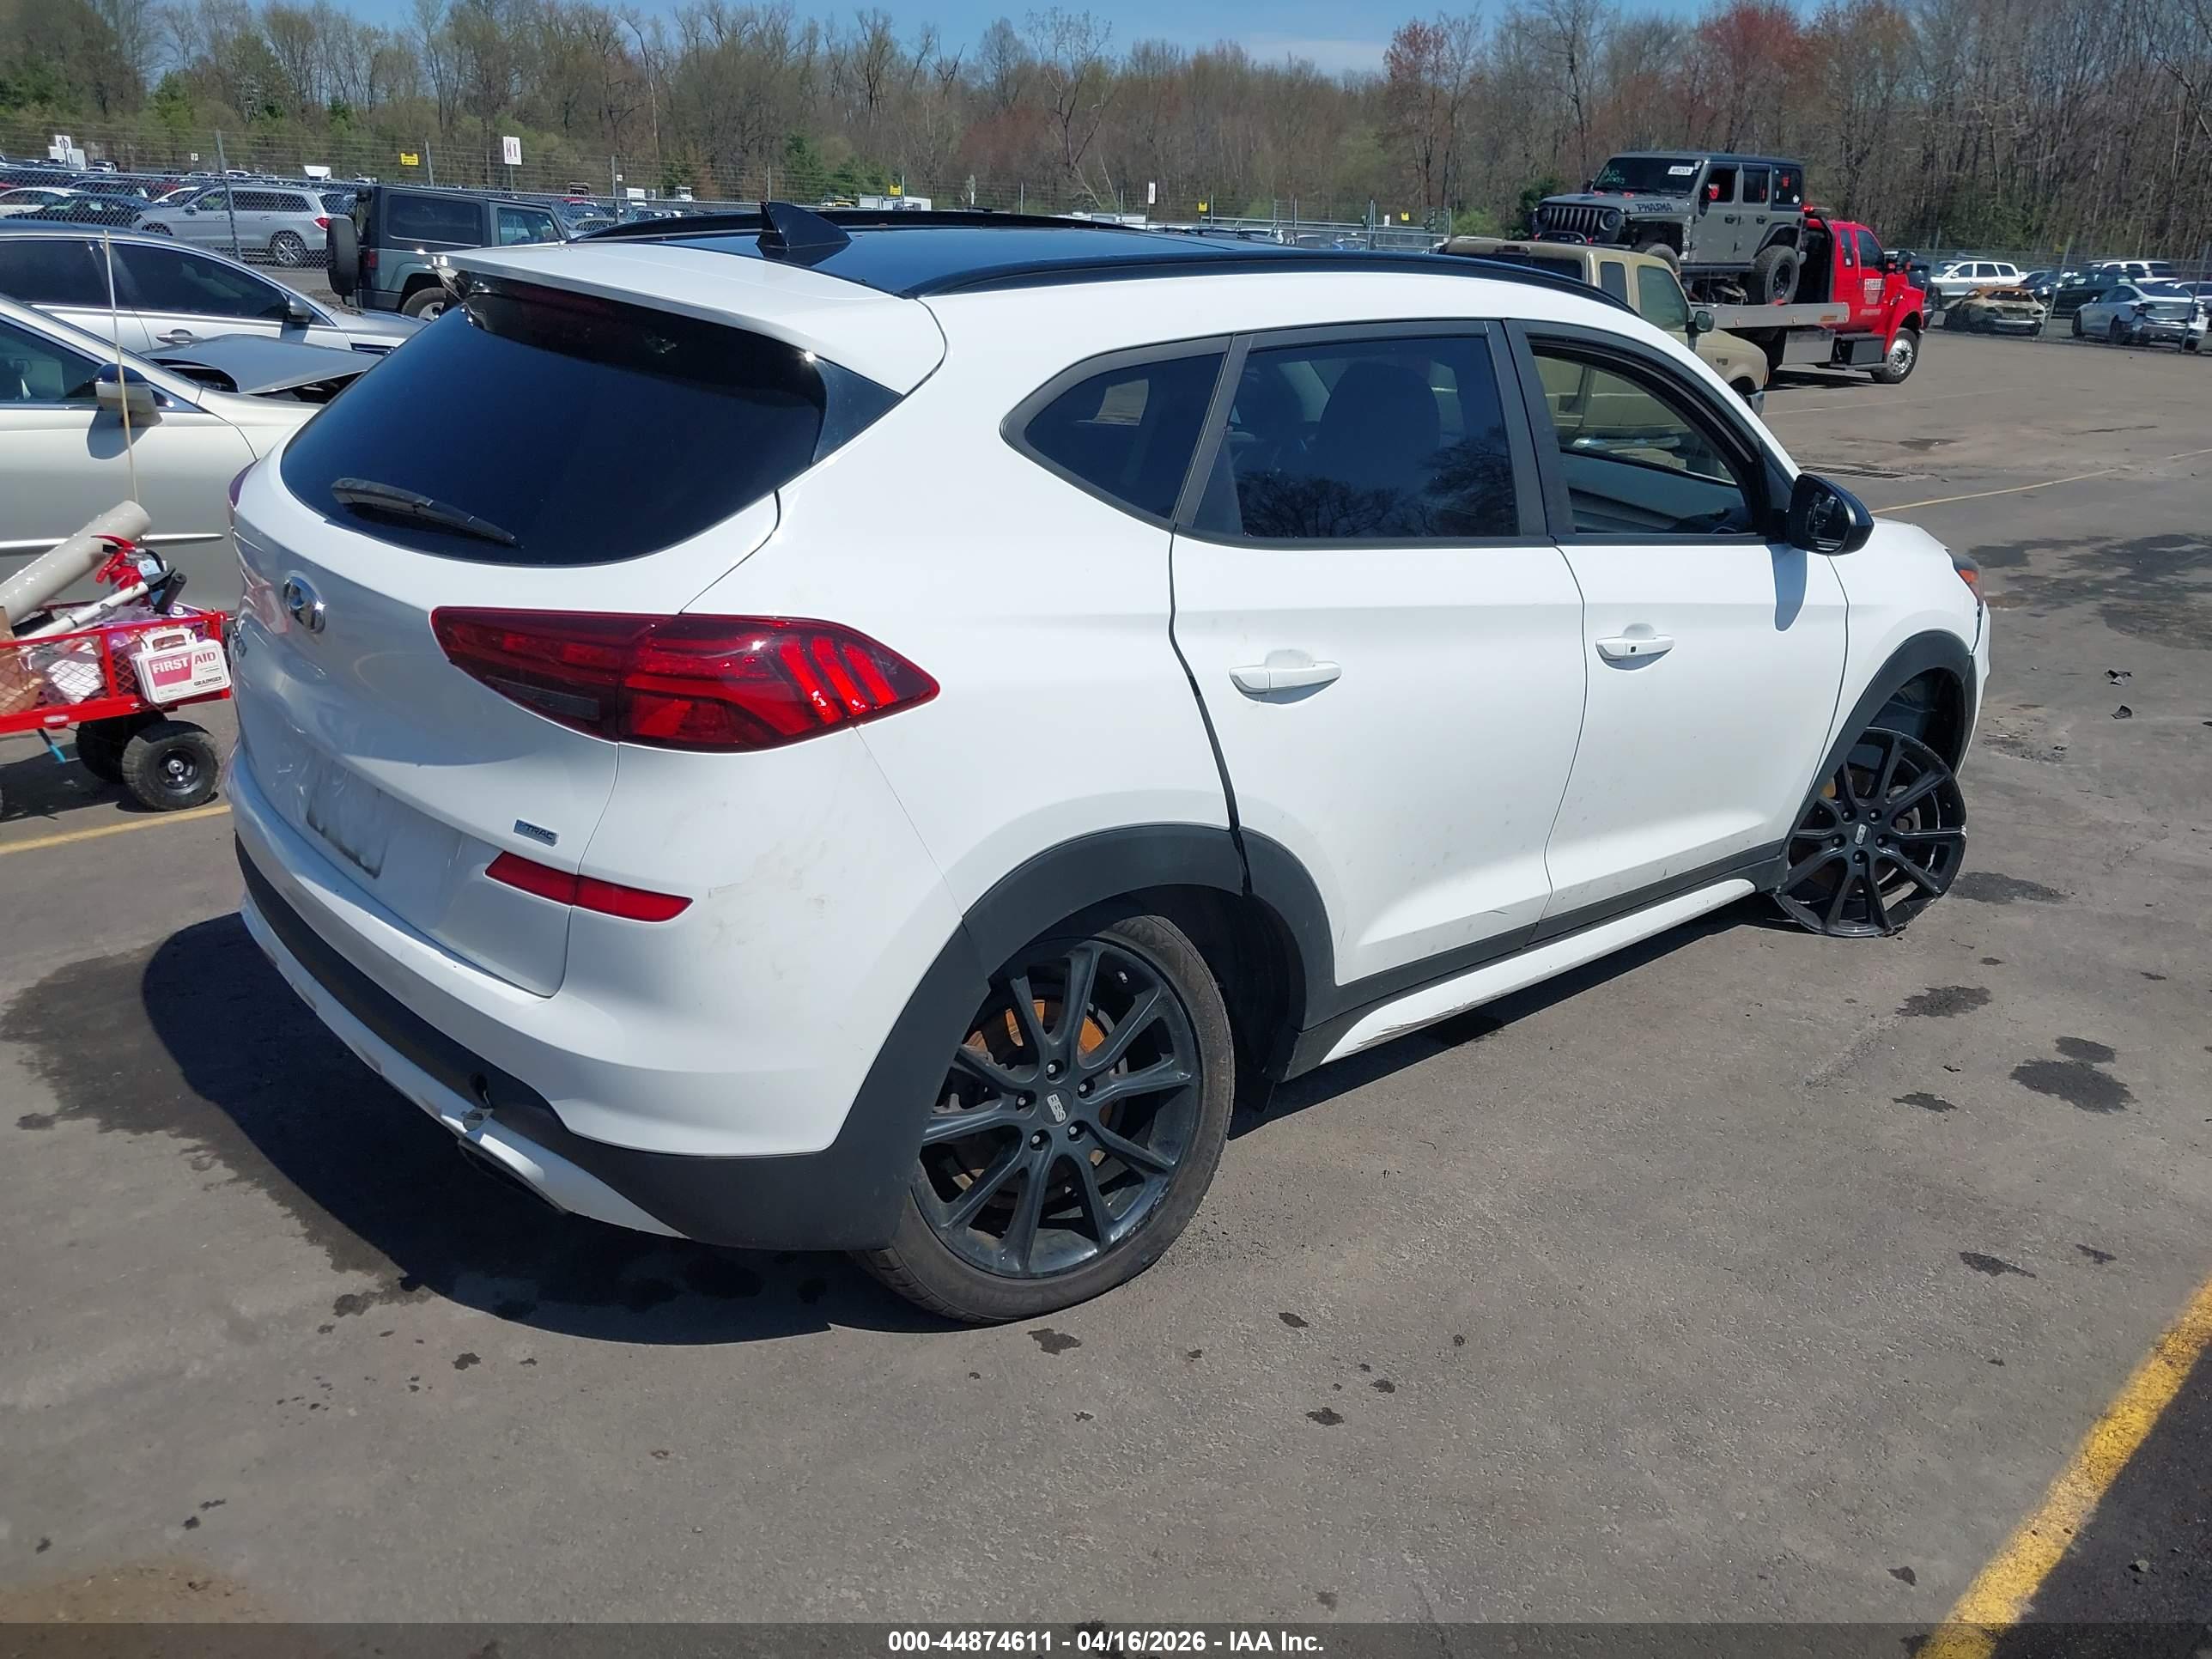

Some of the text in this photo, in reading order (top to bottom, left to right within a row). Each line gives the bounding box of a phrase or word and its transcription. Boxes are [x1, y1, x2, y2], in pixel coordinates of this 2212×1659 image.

[151, 657, 189, 674] FIRST
[194, 652, 216, 665] AID
[1047, 1094, 1066, 1122] BBS
